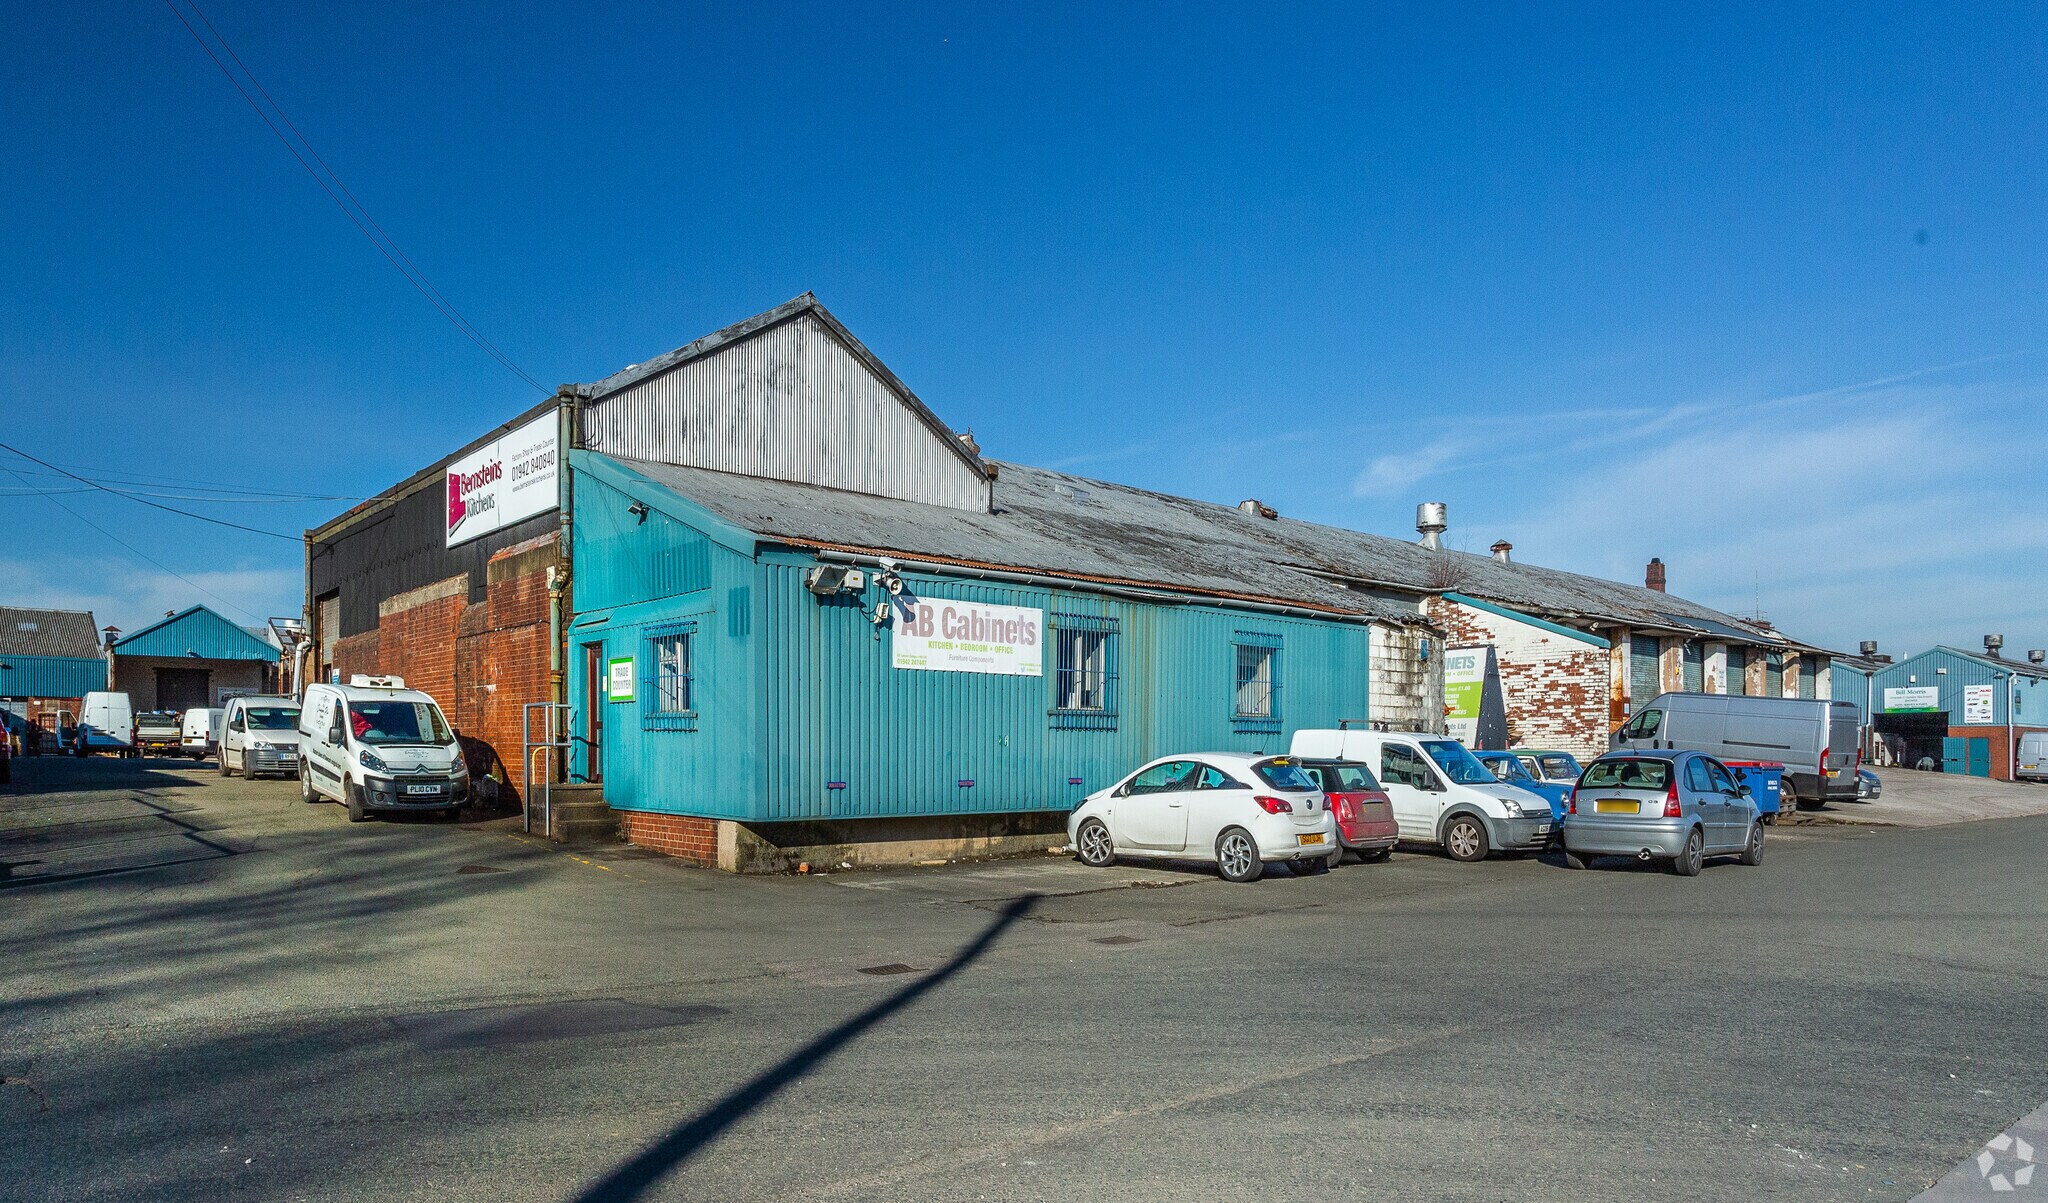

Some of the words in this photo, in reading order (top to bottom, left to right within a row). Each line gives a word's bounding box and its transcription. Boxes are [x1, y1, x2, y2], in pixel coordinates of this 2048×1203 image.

[542, 438, 555, 449] Counter
[512, 460, 529, 482] 01942
[530, 449, 555, 474] 840840
[461, 459, 502, 495] Bernsteins
[466, 493, 495, 518] Kitchens
[901, 603, 934, 638] AB
[942, 606, 1036, 646] Cabinets
[928, 640, 953, 650] KITCHEN
[960, 643, 988, 653] BEDROOM
[995, 646, 1014, 655] OFFICE
[949, 654, 968, 662] Furniture
[969, 656, 994, 664] Components
[1445, 656, 1475, 670] NETS
[615, 667, 628, 677] TRADE
[613, 680, 631, 690] COUNTER
